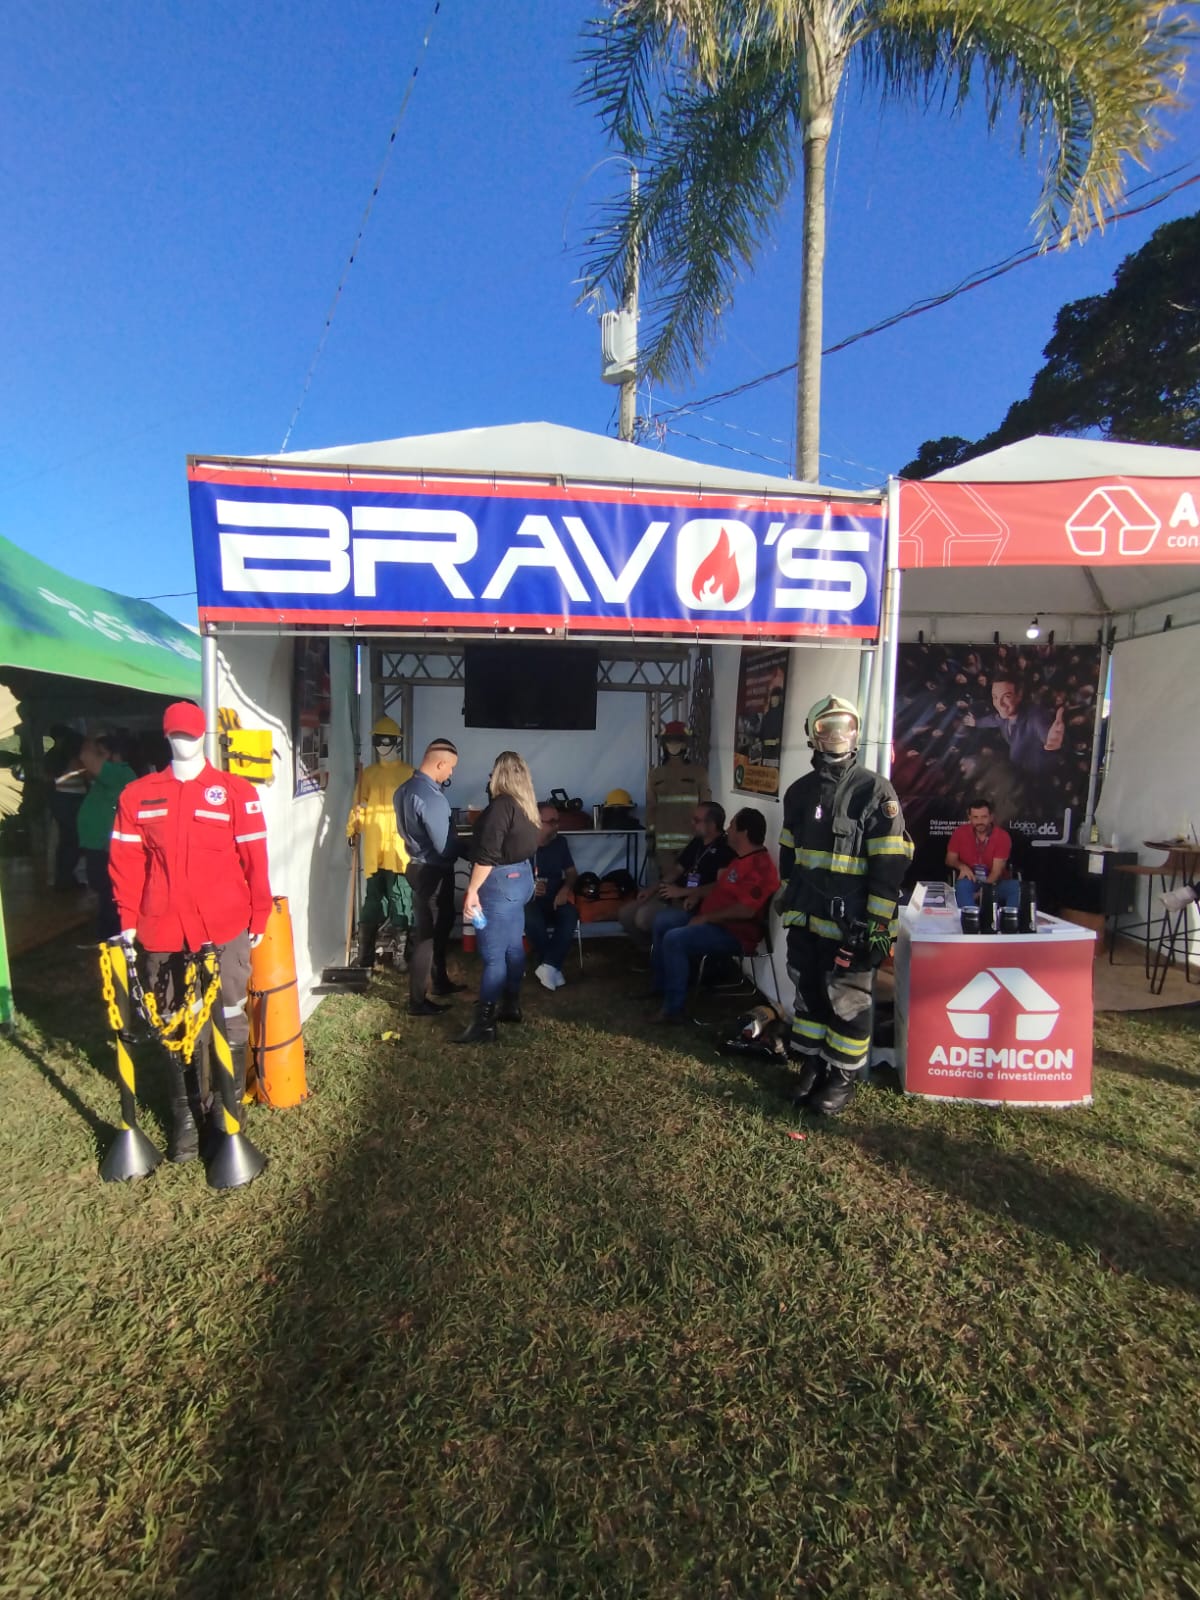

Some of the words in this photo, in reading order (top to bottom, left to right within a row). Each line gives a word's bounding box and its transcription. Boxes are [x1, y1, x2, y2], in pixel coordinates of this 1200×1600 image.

[1167, 535, 1200, 548] con
[216, 499, 869, 611] BRAVO'S
[1009, 819, 1037, 831] Lógico
[928, 1045, 1074, 1070] ADEMICON
[928, 1067, 984, 1080] consórcio
[987, 1072, 993, 1080] e
[997, 1069, 1073, 1081] investimento
